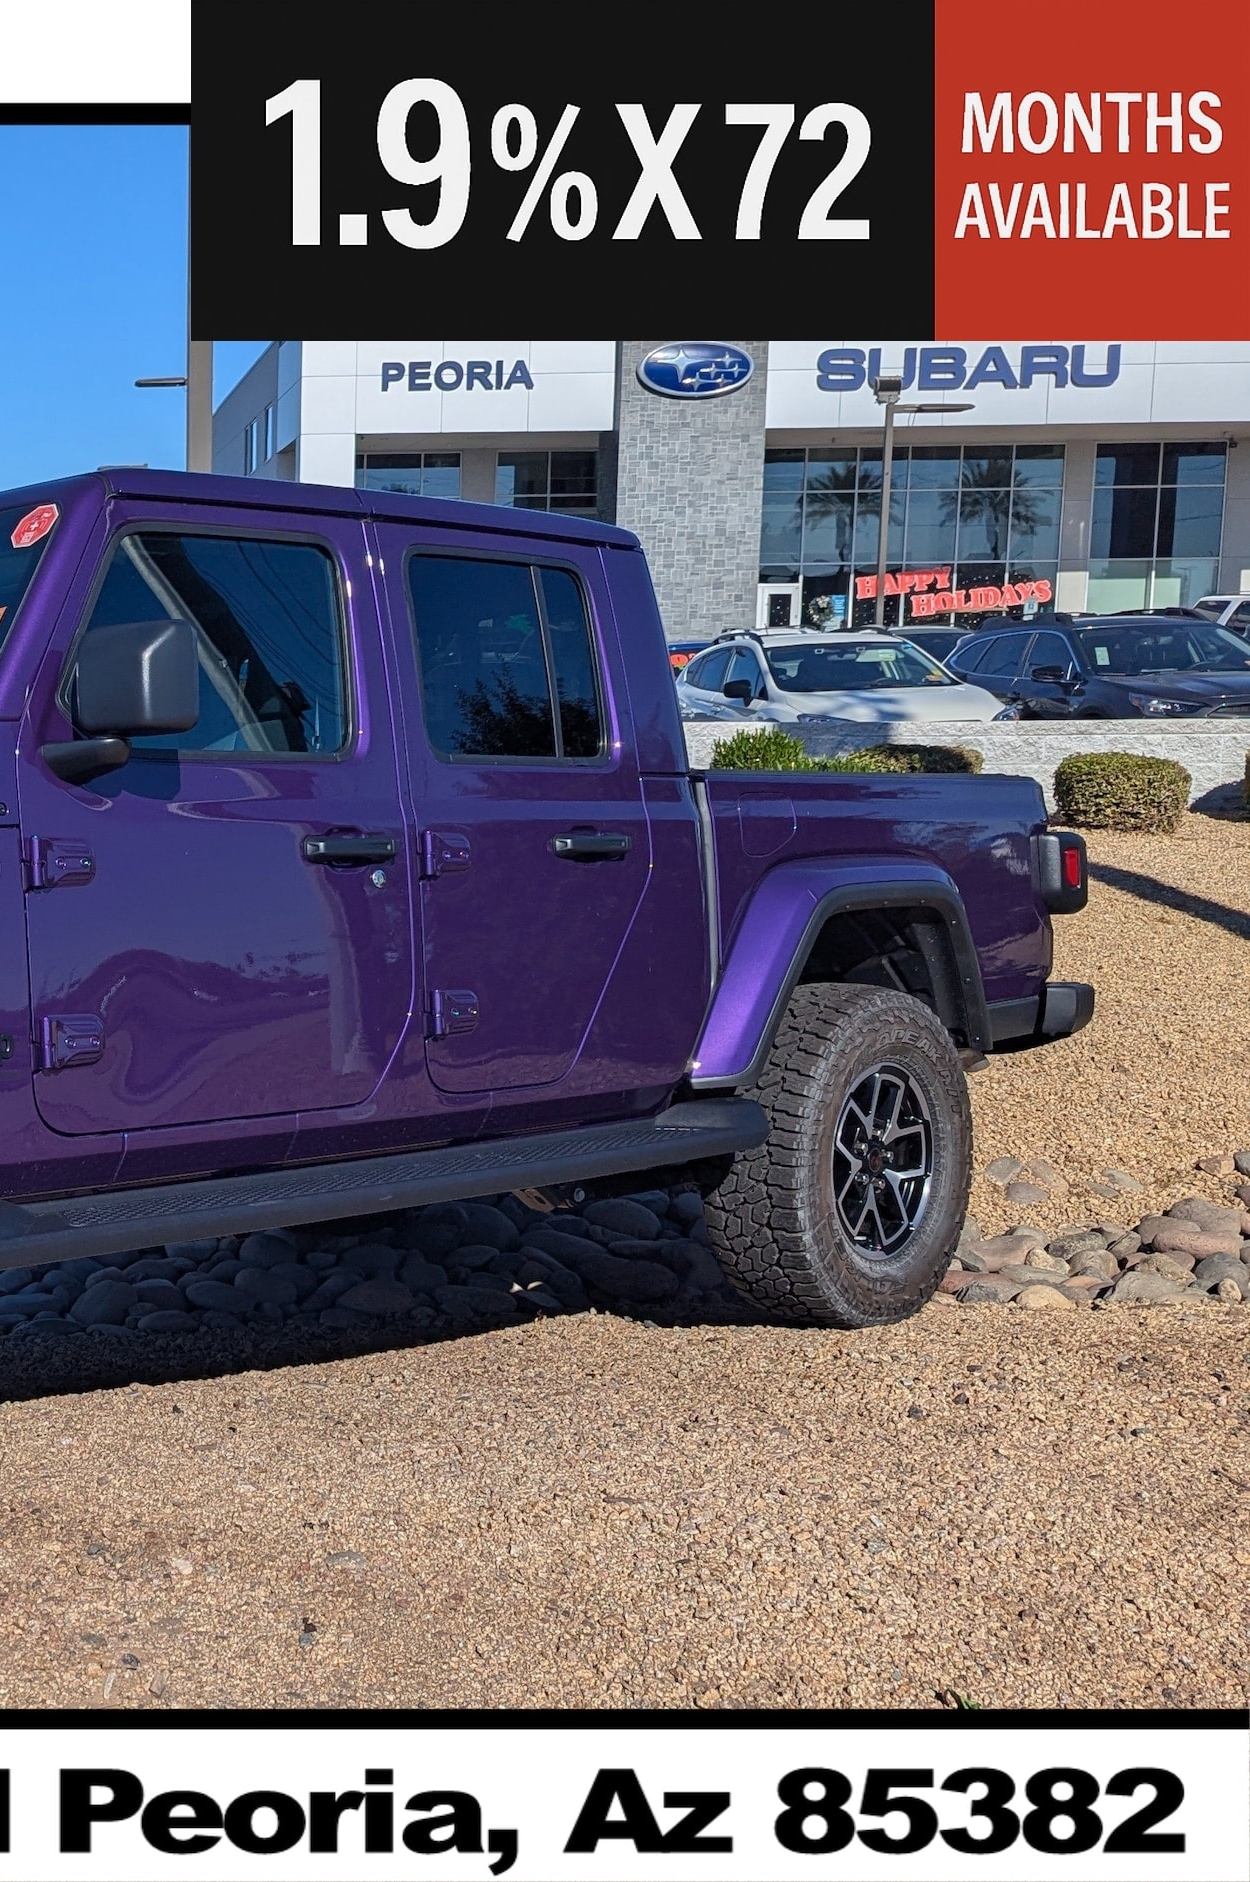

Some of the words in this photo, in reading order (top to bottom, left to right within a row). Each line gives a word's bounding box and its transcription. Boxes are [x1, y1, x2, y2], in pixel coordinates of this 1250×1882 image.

[381, 360, 534, 392] PEORIA
[816, 344, 1121, 391] SUBARU
[855, 566, 952, 600] HAPPY
[910, 579, 1052, 618] HOLIDAYS
